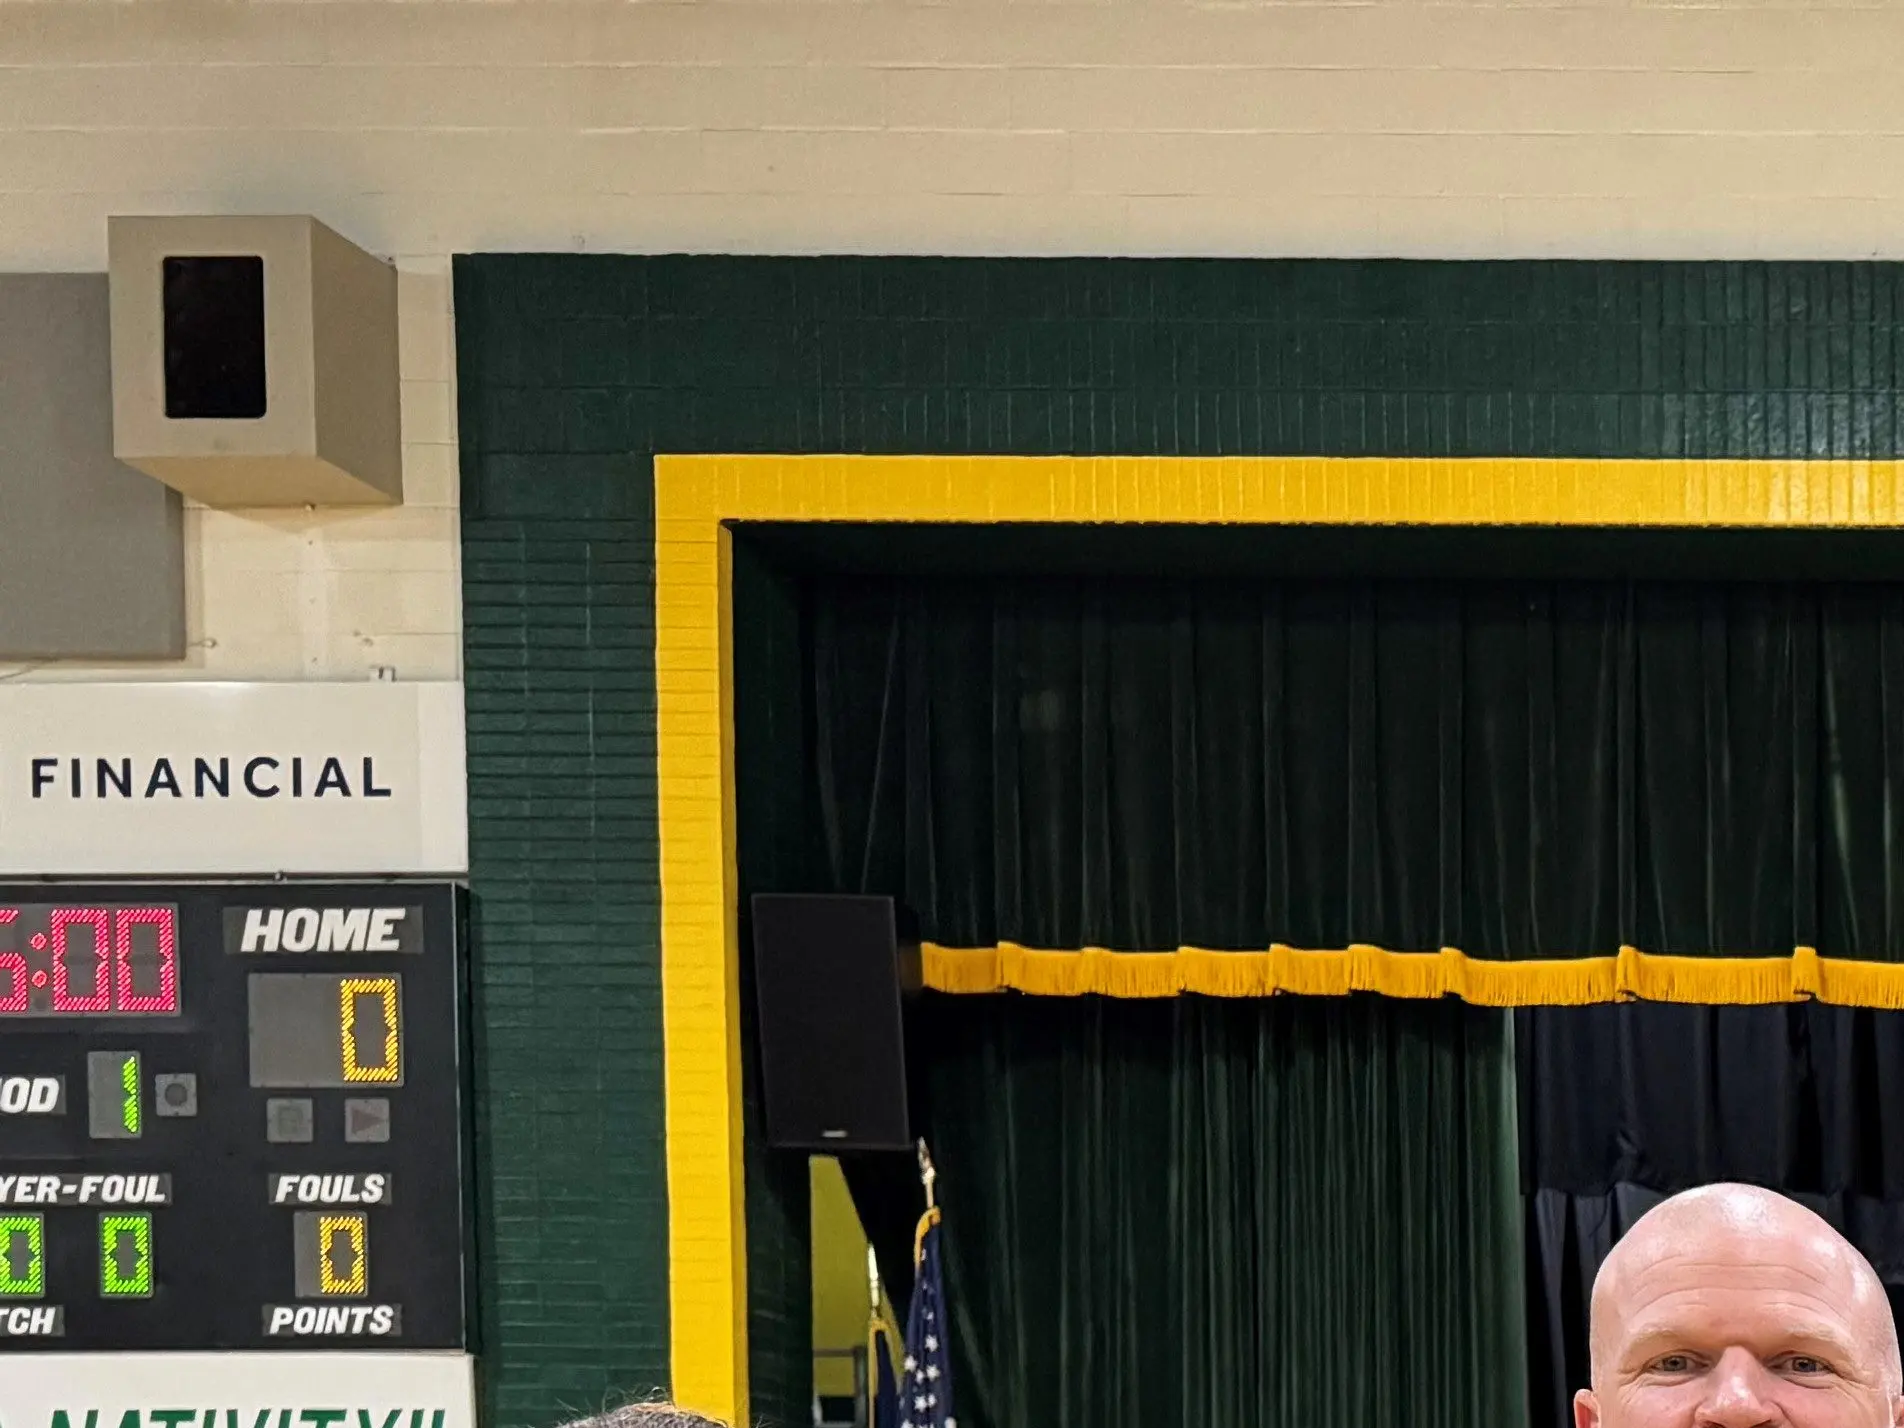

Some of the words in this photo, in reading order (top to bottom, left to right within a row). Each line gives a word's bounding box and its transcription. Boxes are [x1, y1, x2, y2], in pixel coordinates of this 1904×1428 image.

[31, 757, 392, 798] FINANCIAL
[240, 908, 406, 953] HOME
[340, 978, 399, 1082] 0
[0, 1077, 61, 1114] OD
[122, 1056, 139, 1133] 1
[275, 1173, 386, 1203] FOULS
[103, 1216, 150, 1294] 0
[319, 1216, 365, 1294] 0
[269, 1305, 396, 1336] POINTS
